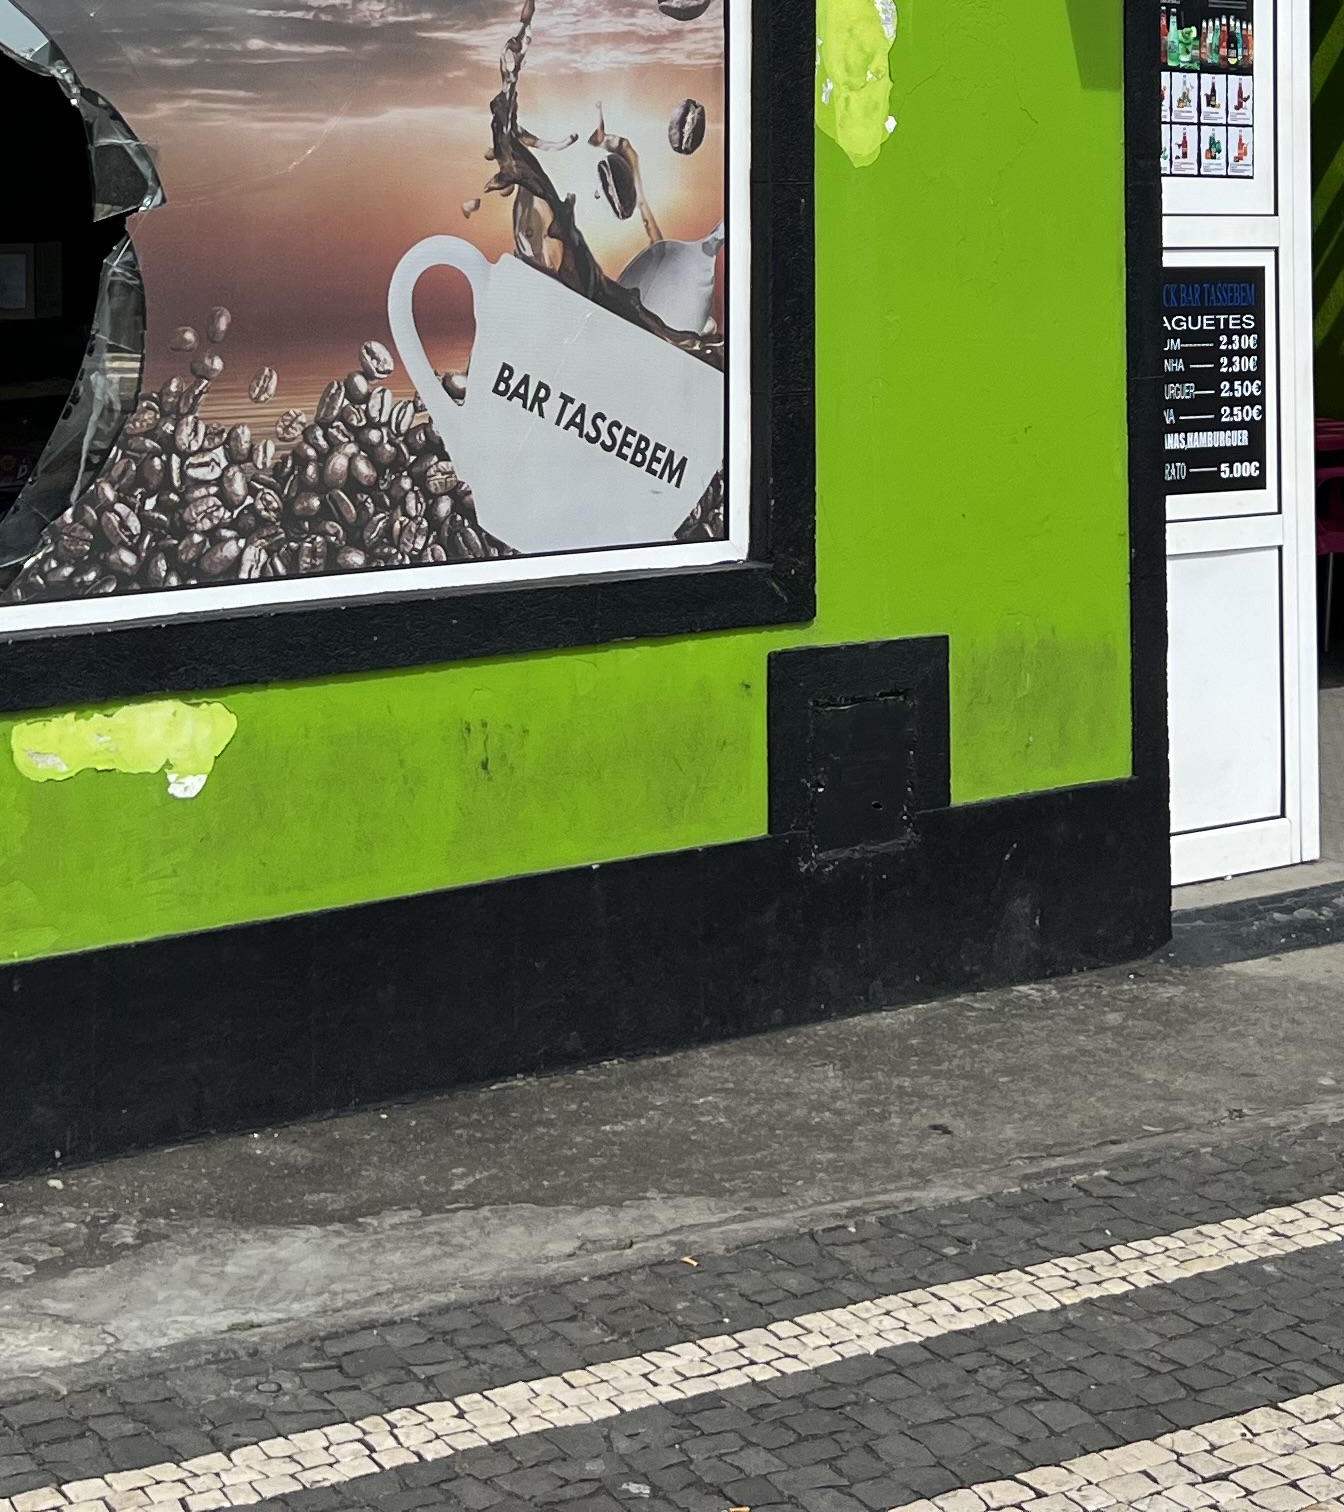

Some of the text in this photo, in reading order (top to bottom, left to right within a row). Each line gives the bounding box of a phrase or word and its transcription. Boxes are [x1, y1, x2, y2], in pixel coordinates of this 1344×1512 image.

[1180, 283, 1202, 307] BAR
[1203, 283, 1256, 307] TASSEBEM
[1162, 313, 1256, 332] AGUETES
[1218, 333, 1259, 352] 2.30€
[1218, 354, 1259, 374] 2.30€
[1164, 379, 1262, 401] URGUER 2.50€
[1219, 404, 1263, 423] 2.50€
[491, 361, 689, 490] BAR TASSEBEM
[1164, 460, 1261, 481] RATO 5.00€
